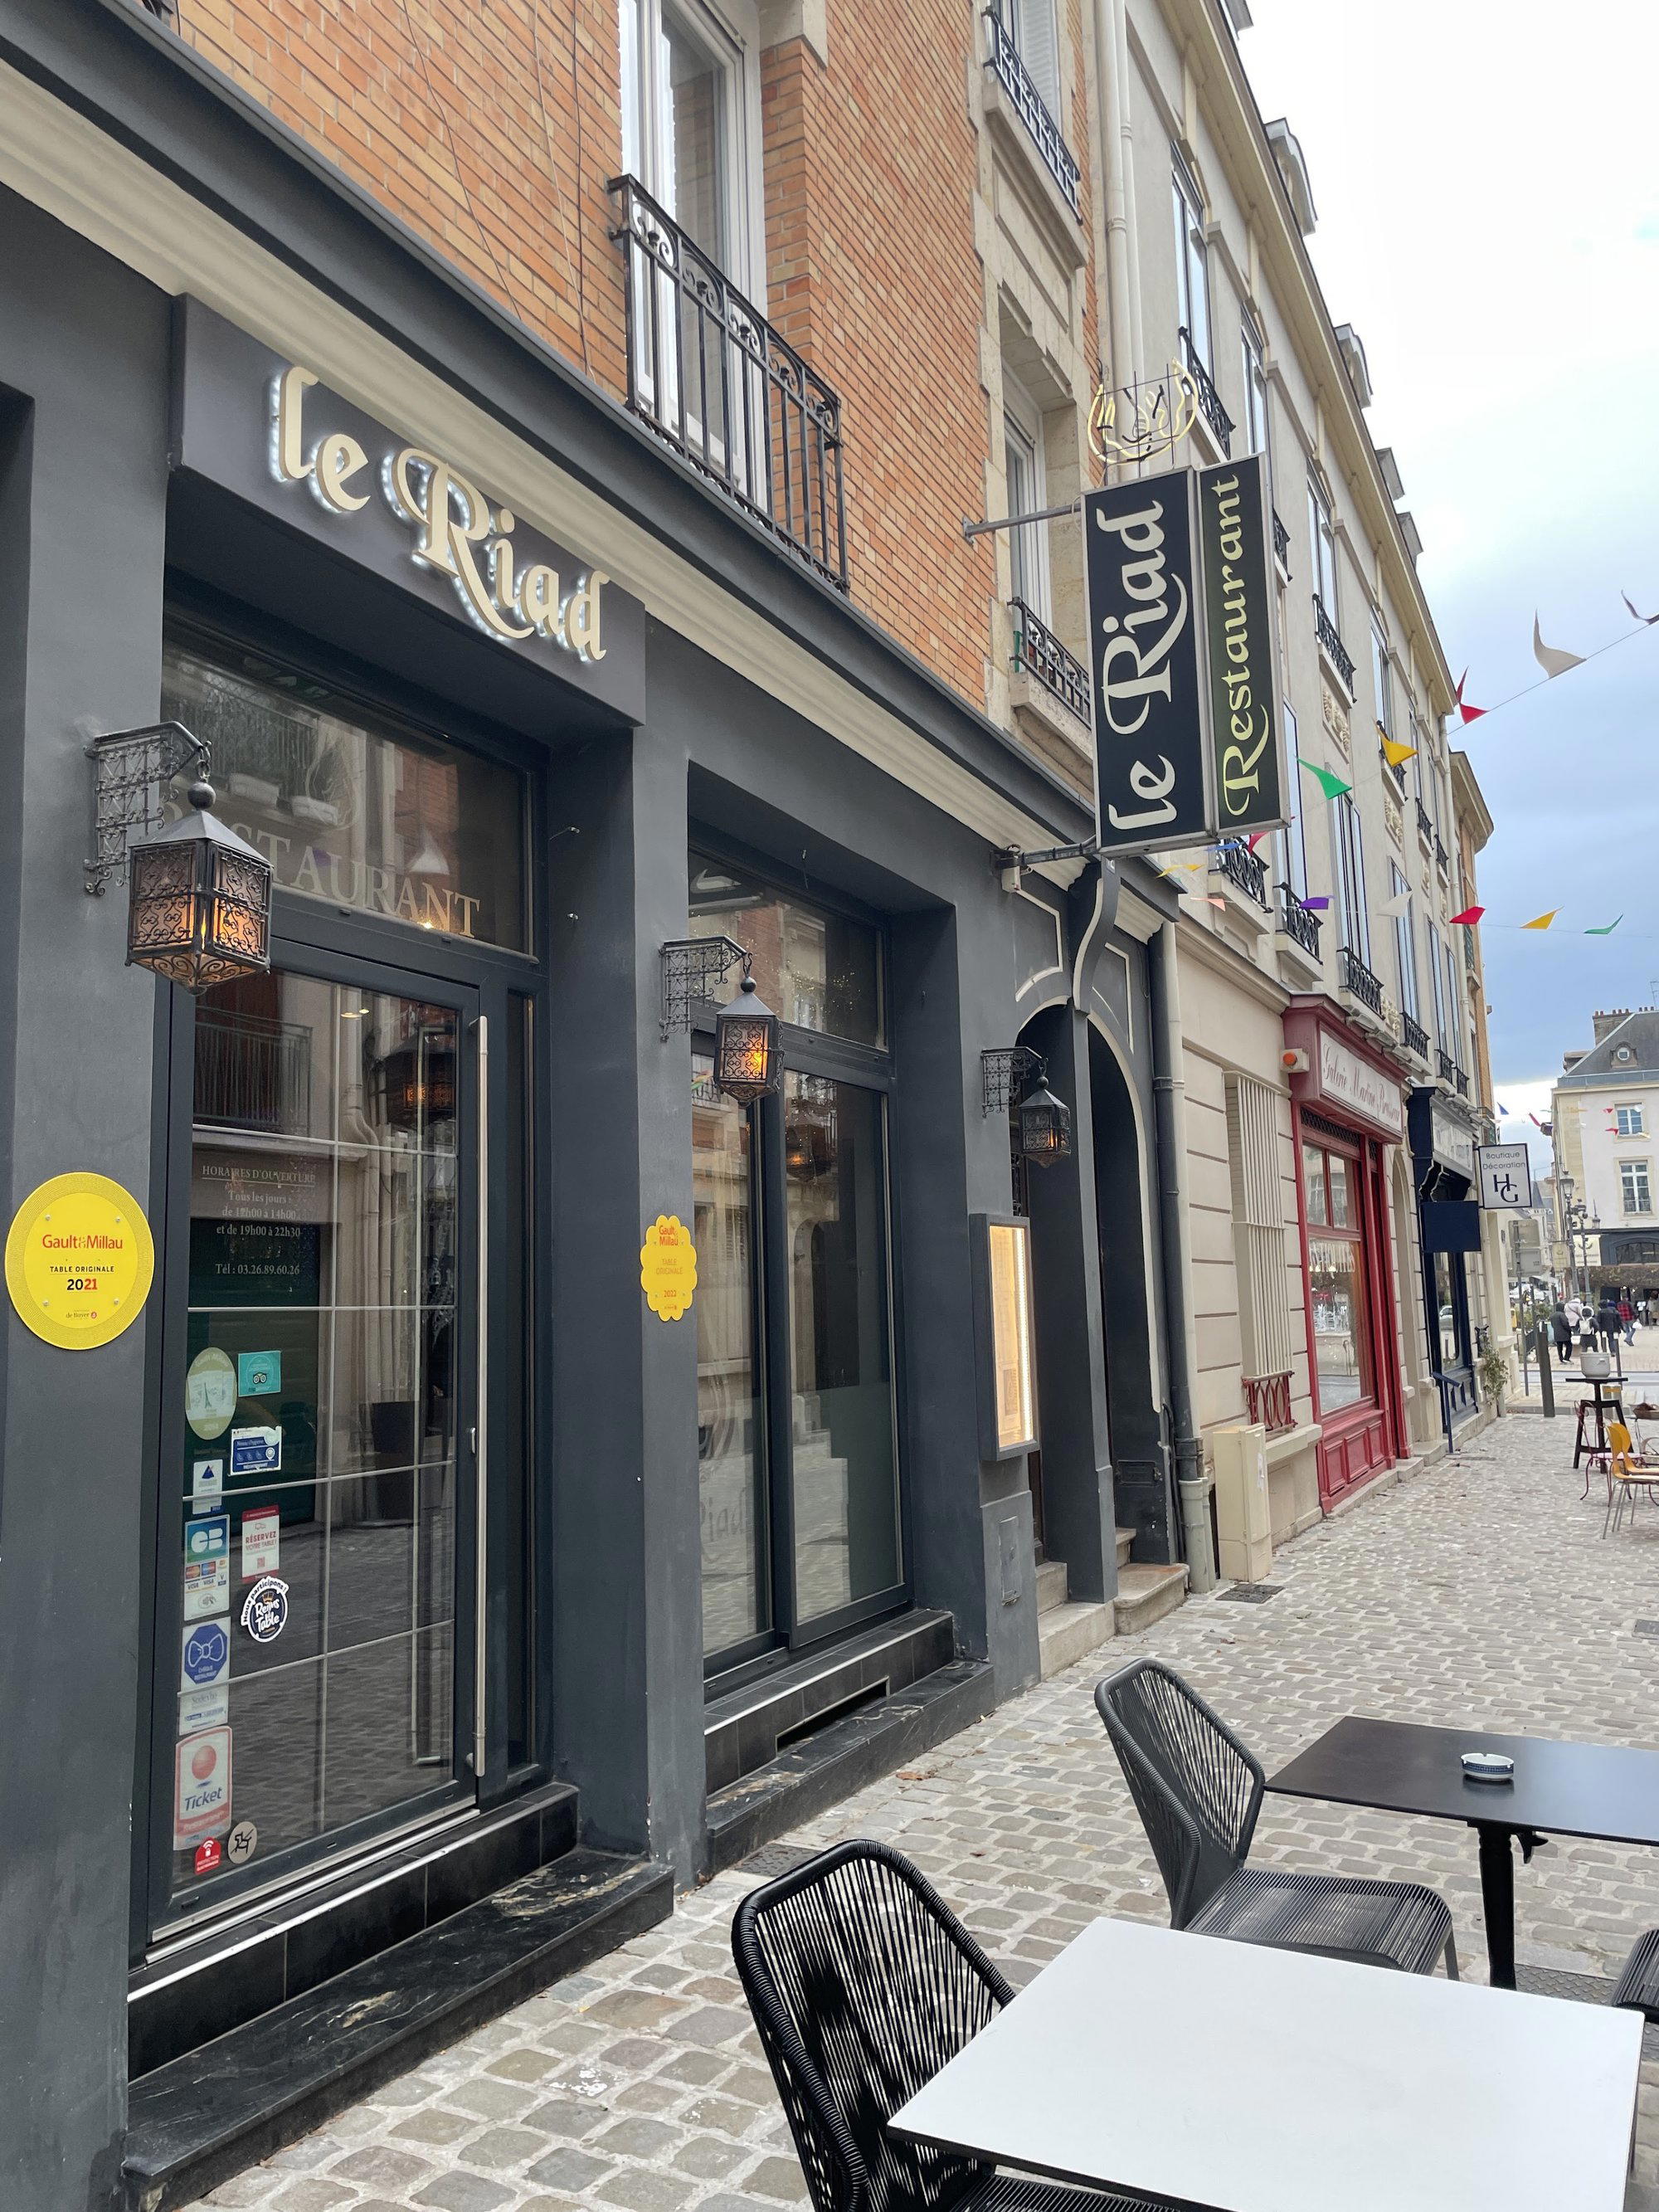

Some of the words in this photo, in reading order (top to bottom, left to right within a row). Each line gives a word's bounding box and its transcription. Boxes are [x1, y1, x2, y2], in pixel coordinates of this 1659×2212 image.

[277, 366, 372, 512] le
[387, 448, 611, 661] Riad
[1096, 499, 1188, 736] Riad
[1211, 473, 1270, 817] Restaurant
[1107, 753, 1178, 831] le
[163, 801, 480, 938] TAURANT
[1486, 1152, 1520, 1160] Boutique
[202, 1165, 251, 1178] HORAIRES
[1482, 1162, 1526, 1170] Décoration
[229, 1191, 251, 1201] Tous
[252, 1191, 264, 1202] les
[221, 1206, 233, 1216] de
[216, 1226, 225, 1235] et
[226, 1224, 237, 1235] de
[240, 1225, 266, 1235] 19h00
[275, 1227, 300, 1237] 22h30
[659, 1236, 679, 1246] Millau
[66, 1278, 98, 1291] 2021
[255, 1611, 280, 1633] Table
[185, 1787, 222, 1811] Ticket
